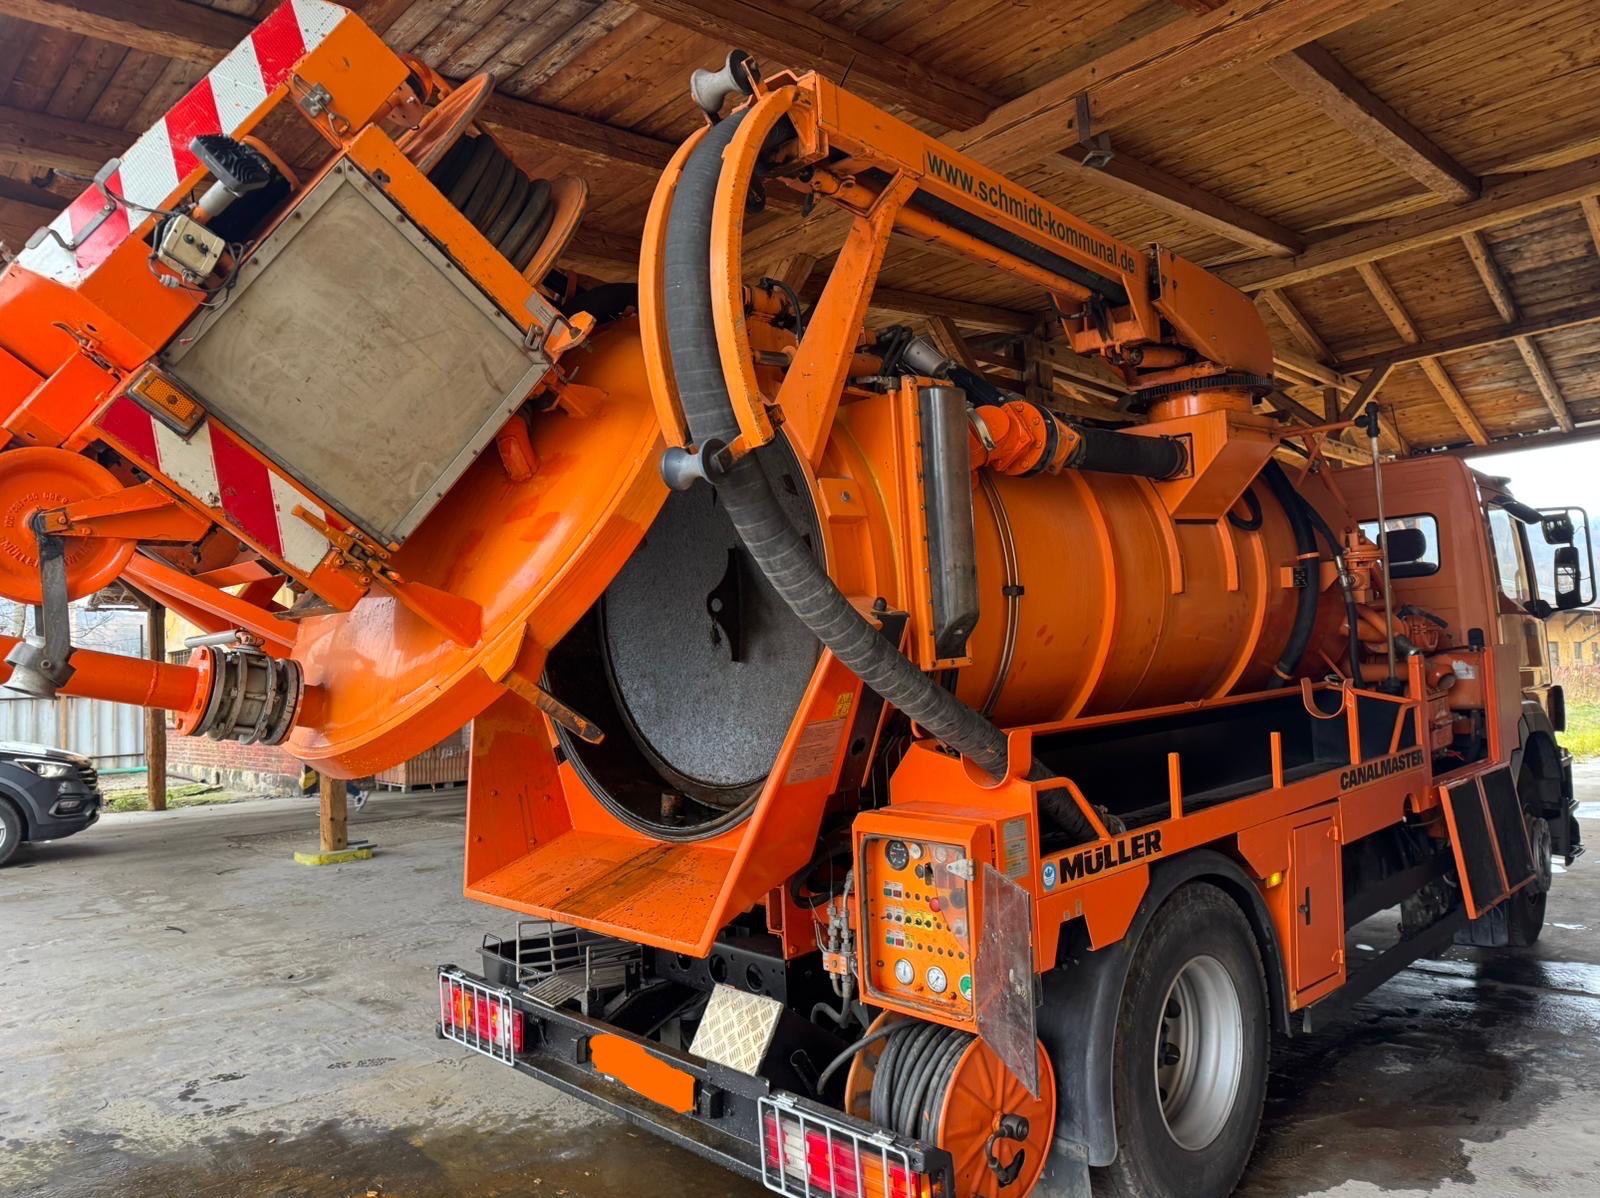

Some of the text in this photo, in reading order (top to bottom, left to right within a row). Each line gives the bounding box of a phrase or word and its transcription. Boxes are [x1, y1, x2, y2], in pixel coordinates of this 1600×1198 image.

[927, 151, 1135, 274] www.schmidt-kommunal.de
[1341, 750, 1424, 790] CANALMASTER
[1060, 829, 1162, 884] MÜLLER
